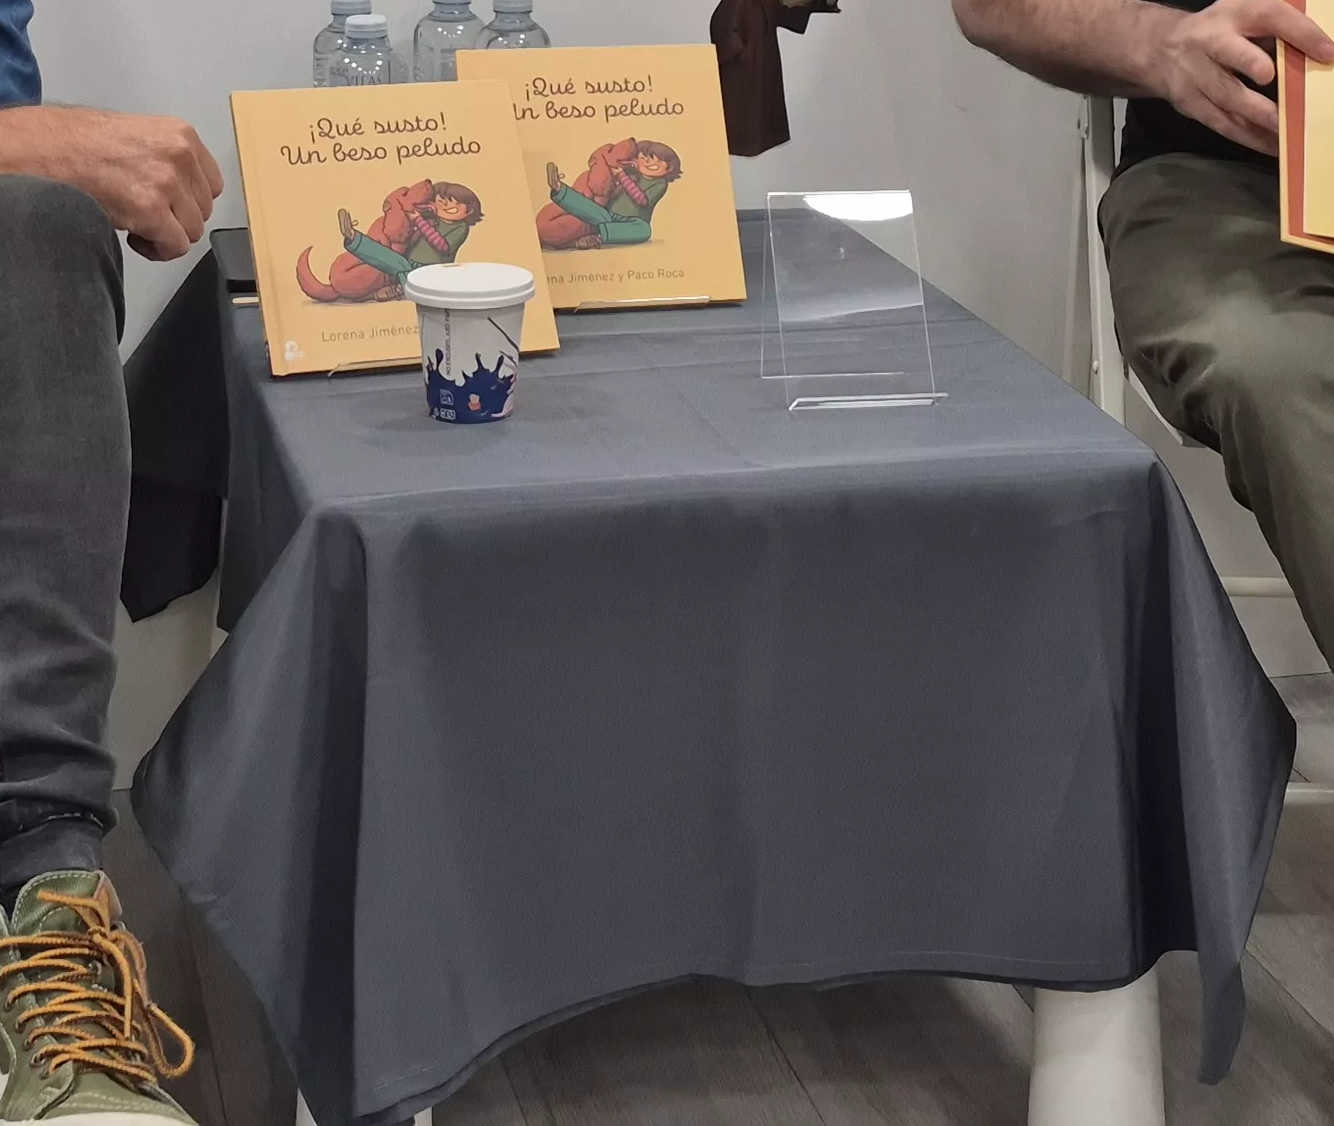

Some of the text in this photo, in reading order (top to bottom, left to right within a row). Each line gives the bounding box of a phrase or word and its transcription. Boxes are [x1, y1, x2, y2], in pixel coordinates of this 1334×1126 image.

[525, 74, 654, 101] ¡Qué susto!
[545, 100, 595, 118] beso
[604, 98, 684, 122] peludo
[310, 112, 447, 144] ¡Qué susto!
[280, 136, 481, 166] Un beso peludo
[568, 270, 615, 284] Jiménez
[618, 274, 624, 282] y
[627, 270, 654, 280] Paco
[657, 268, 685, 278] Roca
[321, 324, 419, 342] Lorena Jiménez
